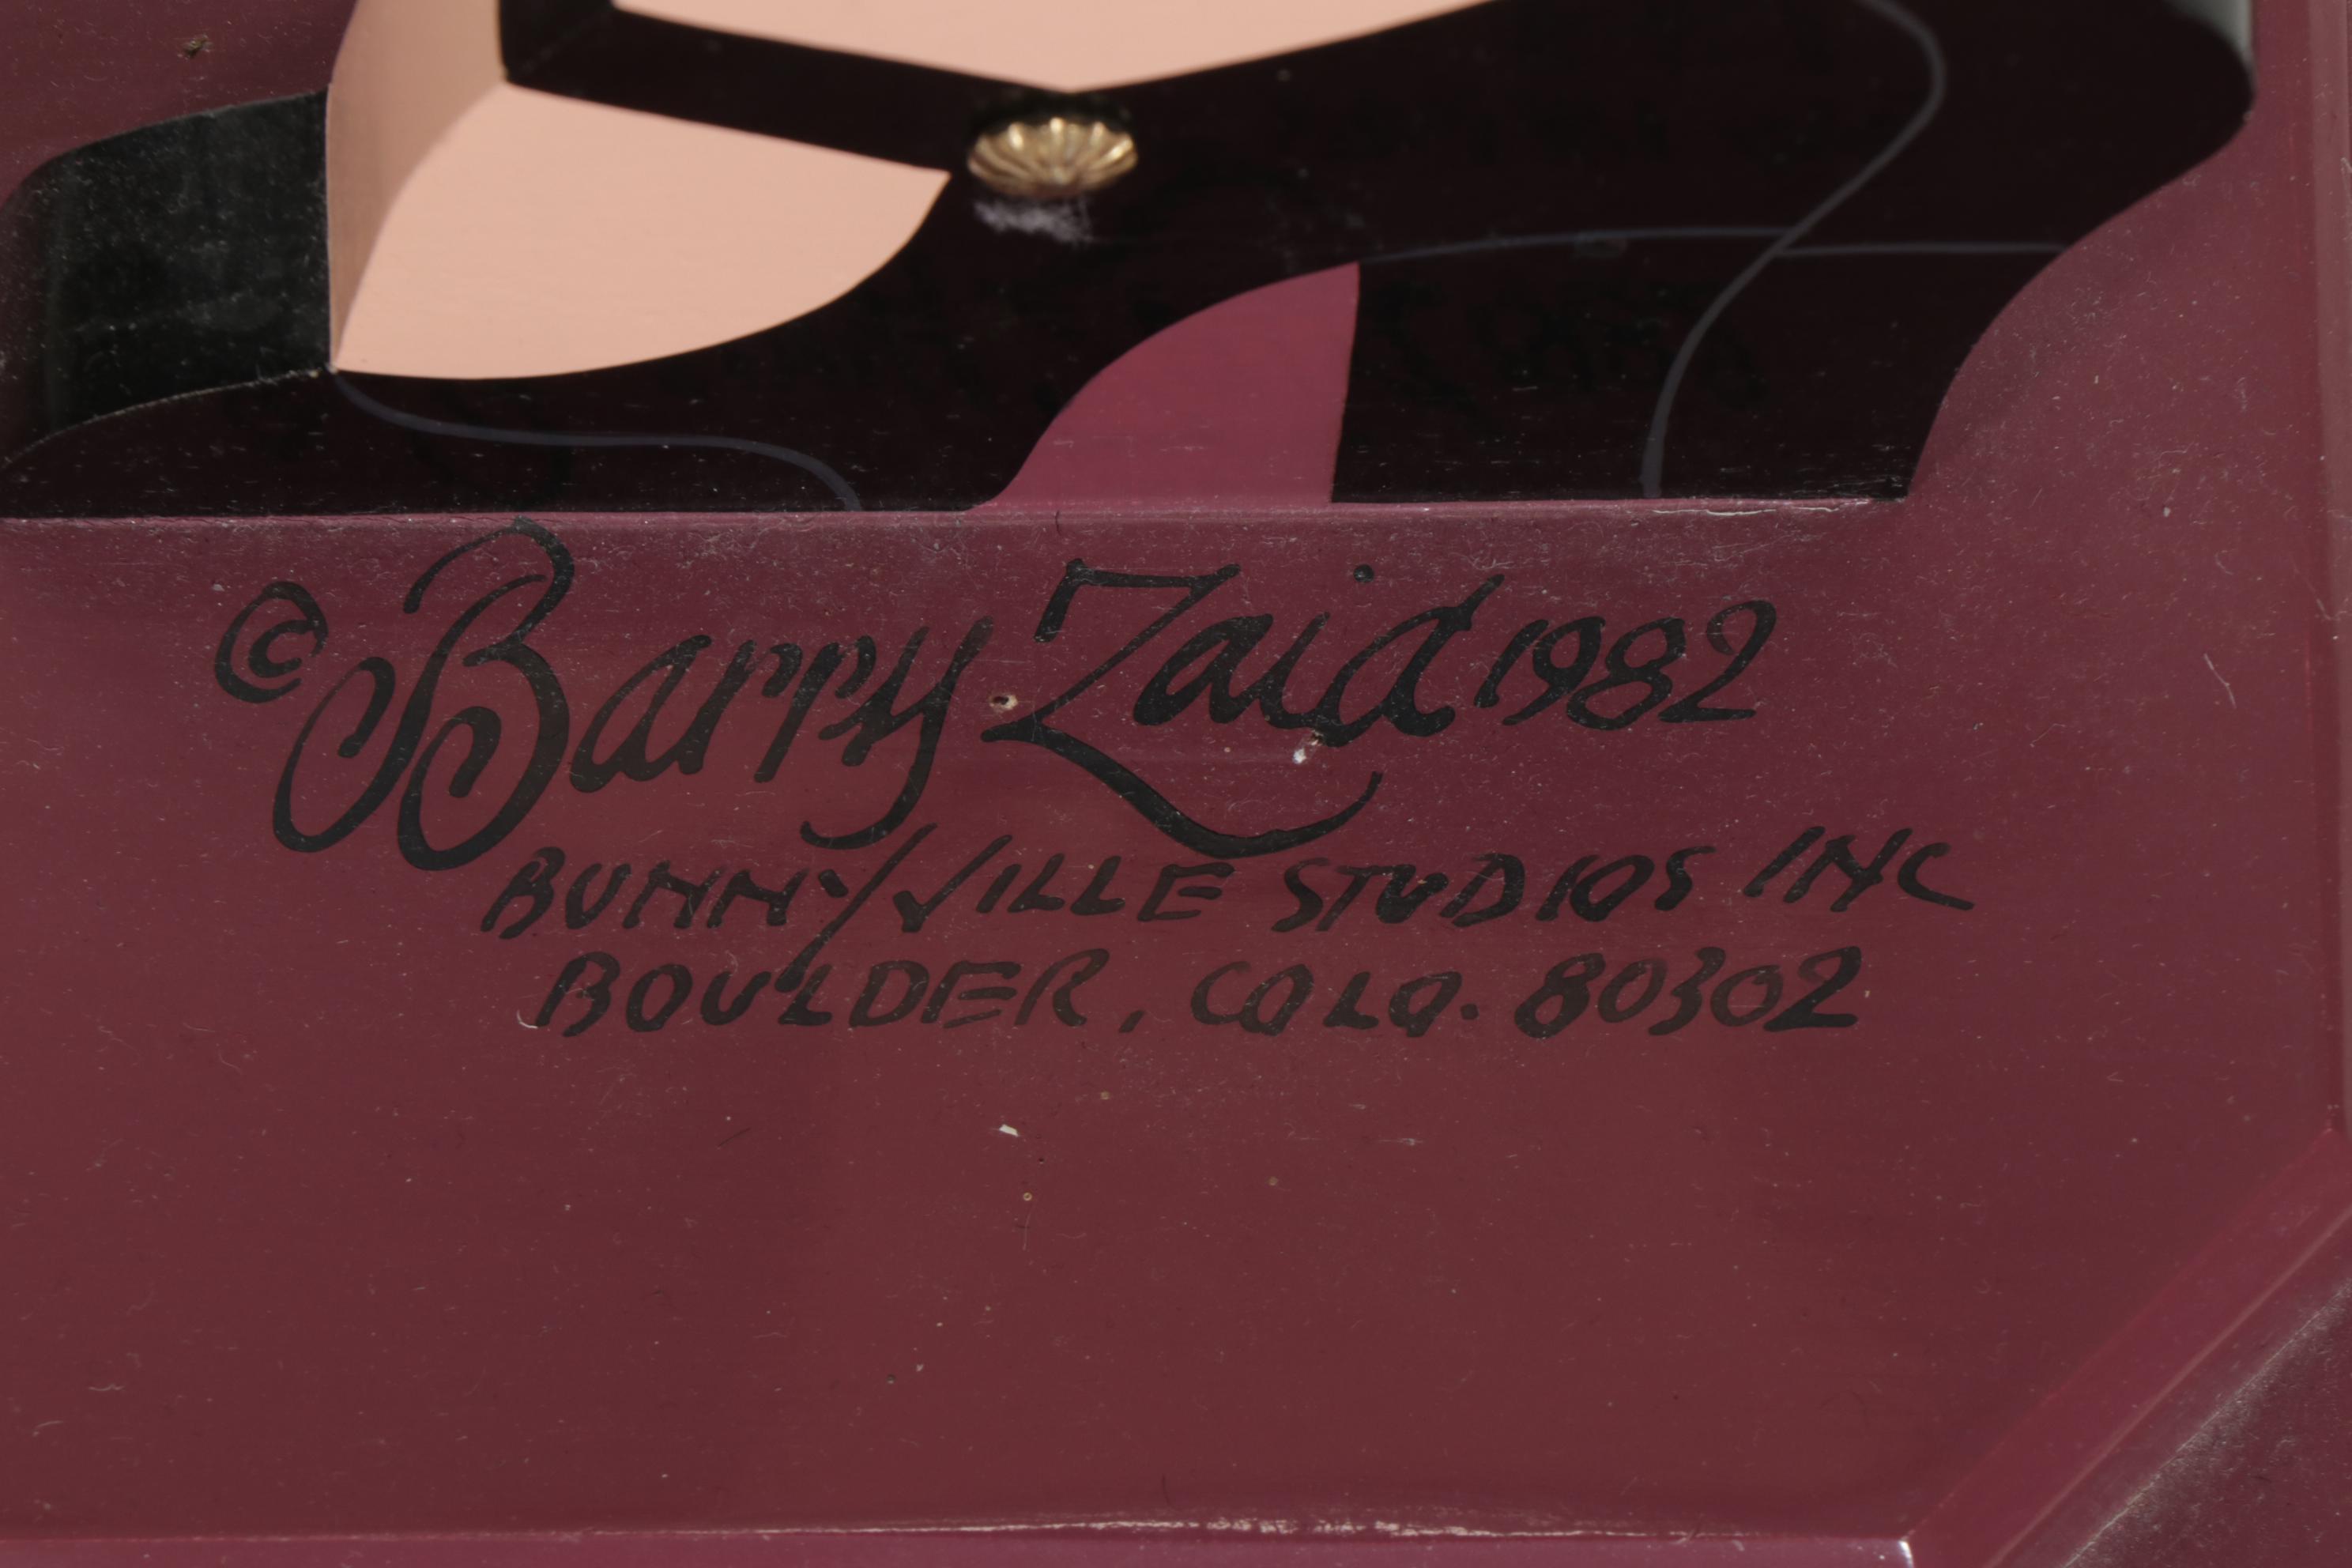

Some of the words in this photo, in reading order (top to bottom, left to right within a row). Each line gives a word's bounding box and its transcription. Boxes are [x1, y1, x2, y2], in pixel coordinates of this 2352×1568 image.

[272, 516, 994, 872] Barry
[980, 557, 1505, 858] Zaid
[1473, 598, 1777, 731] 1982
[481, 823, 1234, 993] BUNNYVILLE
[1271, 845, 1717, 933] STUDIOS
[1742, 825, 1976, 913] INC
[1189, 960, 1479, 1037] COLO.
[1513, 945, 1864, 1040] 80302
